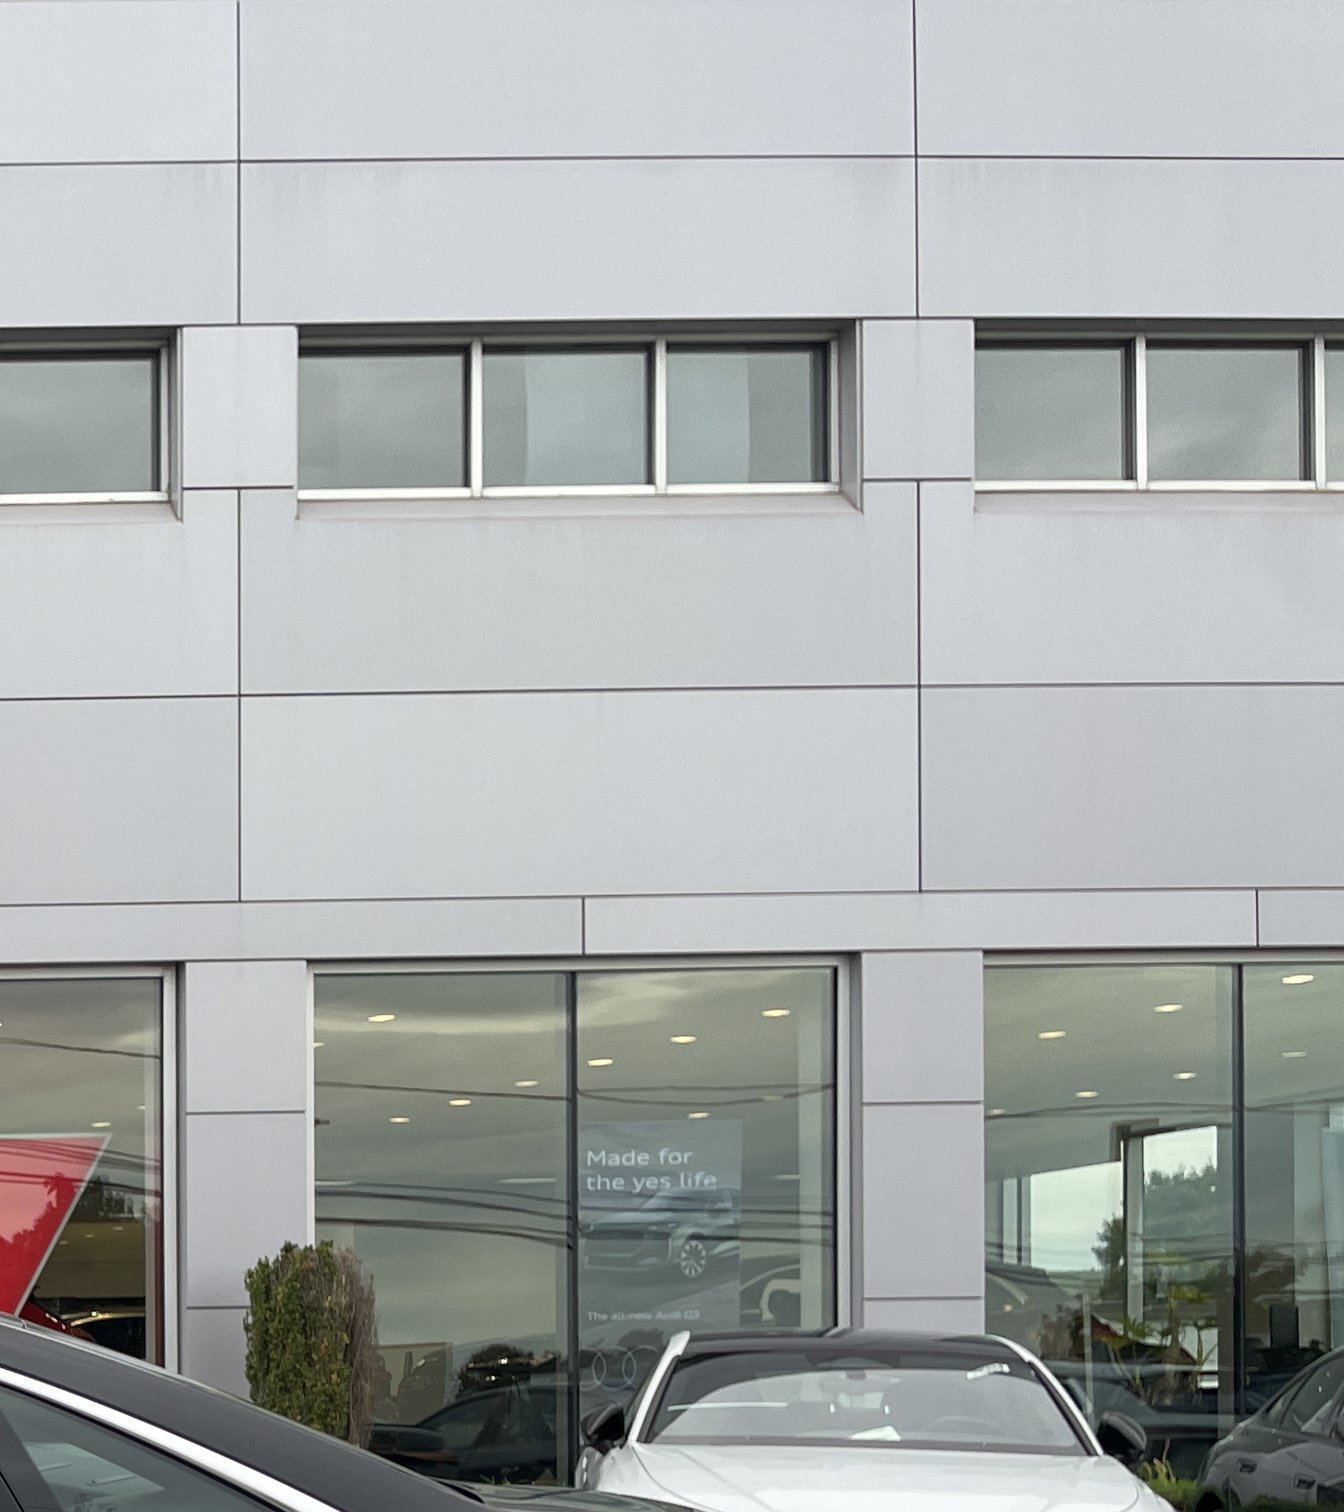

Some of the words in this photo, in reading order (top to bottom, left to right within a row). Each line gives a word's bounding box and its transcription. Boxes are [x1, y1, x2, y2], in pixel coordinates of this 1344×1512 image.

[586, 1149, 650, 1167] Made
[658, 1147, 694, 1165] for
[586, 1174, 625, 1191] the
[632, 1175, 671, 1193] yes
[679, 1171, 718, 1190] life
